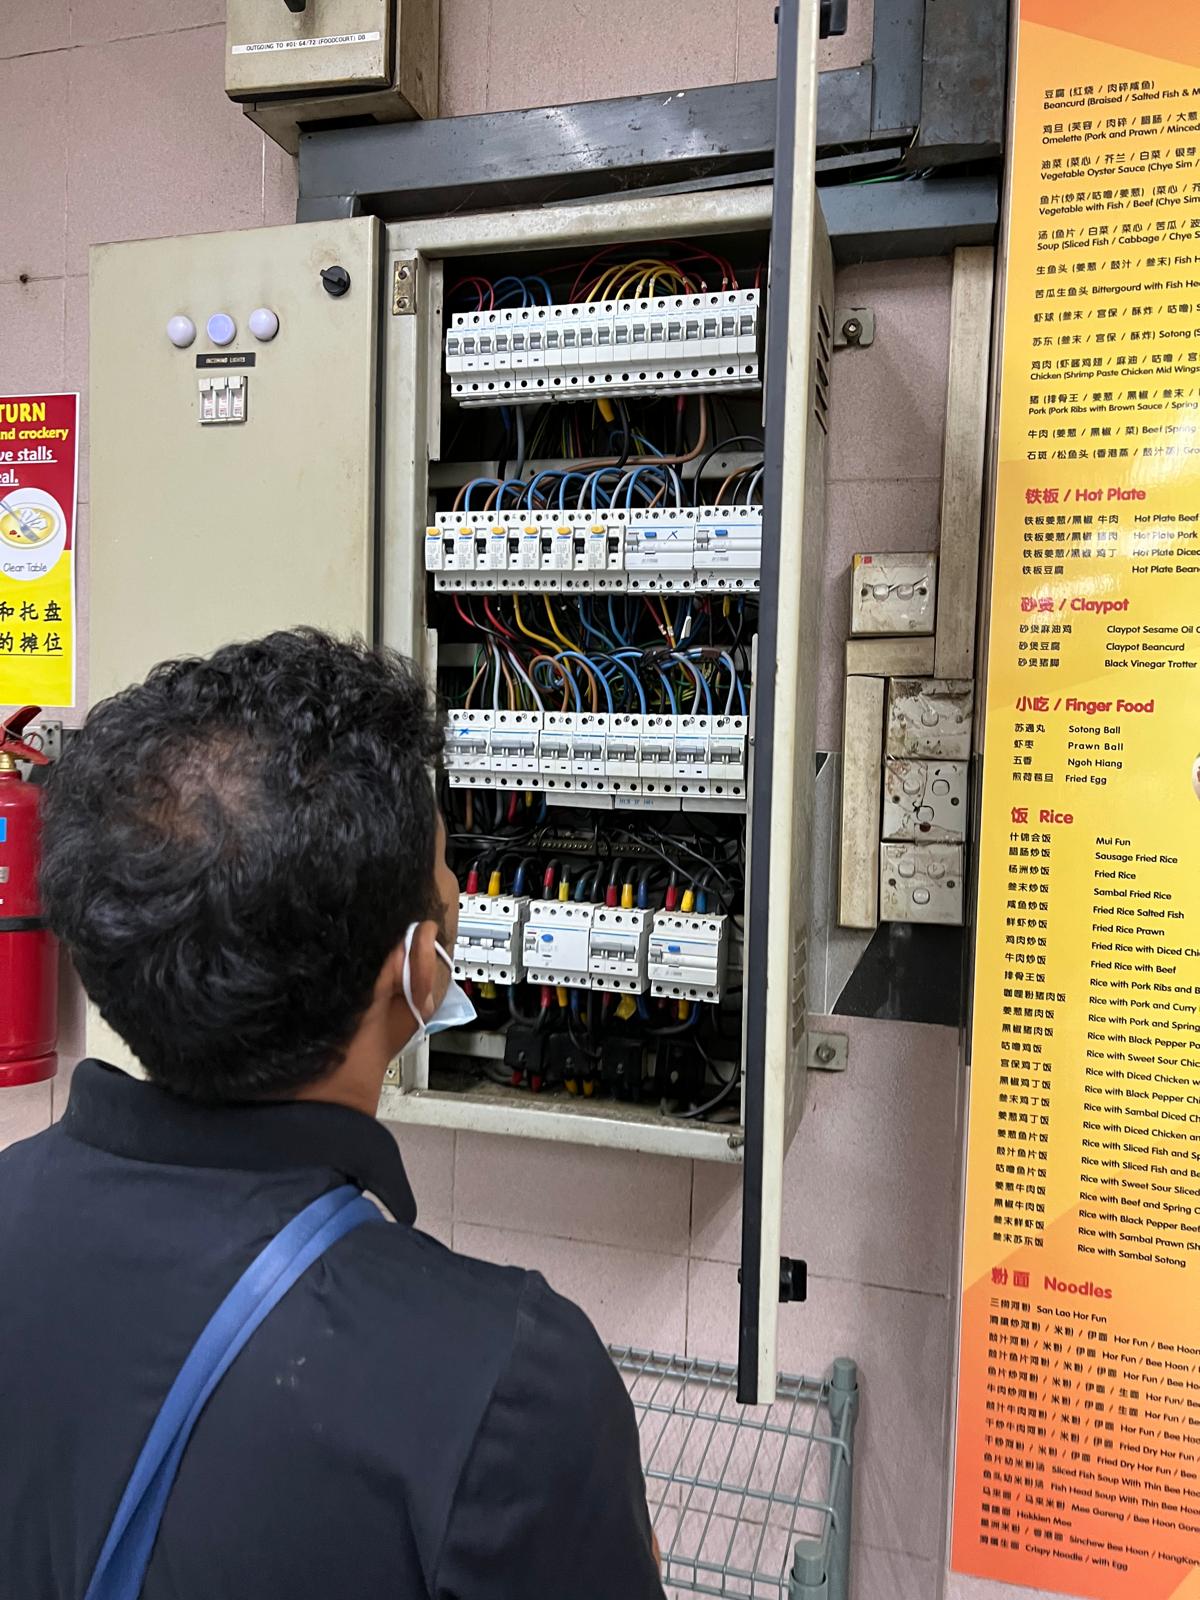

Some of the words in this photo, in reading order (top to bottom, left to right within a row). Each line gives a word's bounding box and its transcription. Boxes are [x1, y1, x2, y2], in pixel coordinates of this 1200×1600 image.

[246, 43, 273, 51] OUTGOING
[1044, 98, 1085, 110] Beancurd
[1088, 95, 1122, 106] (Braised
[1132, 90, 1159, 101] Salted
[1162, 88, 1179, 98] Fish
[1045, 89, 1065, 99] 豆腐
[1042, 132, 1082, 144] Omelette
[1084, 130, 1106, 141] (Pork
[1109, 128, 1126, 138] and
[1129, 127, 1157, 137] Prawn
[1041, 170, 1084, 181] Vegetable
[1087, 168, 1115, 178] Oyster
[1118, 164, 1145, 173] Sauce
[1148, 160, 1173, 172] (Chye
[1176, 158, 1192, 168] Sim
[1037, 242, 1059, 251] Soup
[1062, 239, 1089, 250] (Sliced
[1092, 237, 1109, 245] Fish
[1119, 234, 1159, 244] Cabbage
[1092, 283, 1141, 294] Bittergourd
[1144, 282, 1163, 290] with
[1166, 281, 1182, 289] Fish
[1159, 330, 1191, 339] Sotong
[1031, 372, 1061, 380] Chicken
[1064, 371, 1094, 380] (Shrimp
[1121, 368, 1153, 376] Chicken
[1029, 407, 1046, 415] Pork
[1049, 406, 1068, 415] (Pork
[1071, 405, 1087, 413] Ribs
[1090, 404, 1106, 412] with
[19, 427, 69, 440] crockery
[1142, 425, 1162, 434] Beef
[18, 446, 52, 460] stalls
[0, 469, 19, 483] al.
[1026, 488, 1059, 504] 铁板
[1075, 489, 1103, 501] Hot
[1107, 487, 1146, 501] Plate
[1134, 514, 1150, 522] Hot
[1153, 514, 1176, 522] Plate
[1178, 513, 1199, 522] Beef
[3, 562, 25, 572] Clear
[27, 563, 47, 572] Table
[1132, 566, 1148, 574] Hot
[1151, 565, 1173, 574] Plate
[1071, 598, 1129, 614] Claypot
[1107, 626, 1141, 635] Claypot
[1143, 626, 1178, 634] Sesame
[1106, 643, 1140, 652] Claypot
[1142, 643, 1184, 651] Beancurd
[1131, 660, 1165, 669] Vinegar
[1168, 660, 1197, 668] Trotter
[1016, 696, 1049, 712] 小吃
[1066, 698, 1112, 714] Finger
[1116, 699, 1154, 713] Food
[1069, 725, 1100, 735] Sotong
[1104, 726, 1120, 734] Ball
[1068, 742, 1100, 750] Prawn
[1104, 743, 1123, 751] Ball
[1013, 756, 1032, 765] 五香
[1068, 758, 1092, 767] Ngoh
[1095, 760, 1122, 769] Hiang
[1065, 774, 1087, 783] Fried
[1090, 776, 1107, 785] Egg
[1011, 807, 1028, 824] 饭
[1040, 810, 1073, 824] Rice
[1096, 837, 1112, 845] Mui
[1115, 838, 1130, 846] Fun
[1095, 852, 1133, 862] Sausage
[1135, 854, 1157, 863] Fried
[1159, 855, 1178, 864] Rice
[1094, 888, 1127, 897] Sambal
[1130, 890, 1150, 898] Fried
[1153, 891, 1172, 900] Rice
[1093, 906, 1114, 914] Fried
[1117, 908, 1134, 916] Rice
[1137, 909, 1165, 918] Salted
[1168, 911, 1184, 919] Fish
[1092, 924, 1113, 932] Fried
[1116, 925, 1133, 934] Rice
[1136, 927, 1165, 936] Prawn
[1136, 945, 1154, 954] with
[1157, 947, 1182, 955] Diced
[1091, 960, 1112, 969] Fried
[1156, 965, 1176, 974] Beef
[1089, 996, 1107, 1005] Rice
[1109, 998, 1127, 1007] with
[1131, 1000, 1150, 1009] Pork
[1153, 1002, 1170, 1010] and
[1173, 1003, 1196, 1014] Curry
[1129, 1036, 1152, 1045] Black
[1155, 1038, 1186, 1049] Pepper
[1128, 1053, 1155, 1063] Sweet
[1157, 1056, 1178, 1065] Sour
[1127, 1071, 1152, 1081] Diced
[1154, 1073, 1189, 1085] Chicken
[1125, 1107, 1158, 1118] Sambal
[1161, 1111, 1186, 1122] Diced
[1123, 1143, 1149, 1153] Sliced
[1152, 1147, 1168, 1156] Fish
[1077, 1244, 1095, 1254] Rice
[1098, 1247, 1116, 1257] with
[1119, 1250, 1152, 1262] Sambal
[1154, 1255, 1186, 1267] Sotong
[1044, 1276, 1112, 1299] Noodles
[1037, 1305, 1053, 1315] San
[1073, 1310, 1089, 1320] Hor
[1092, 1314, 1107, 1323] Fun
[1016, 1510, 1050, 1524] Hokkien
[1053, 1516, 1072, 1527] Mee
[1025, 1544, 1050, 1556] Crispy
[1053, 1549, 1083, 1562] Noodle
[1112, 1560, 1128, 1571] Egg
